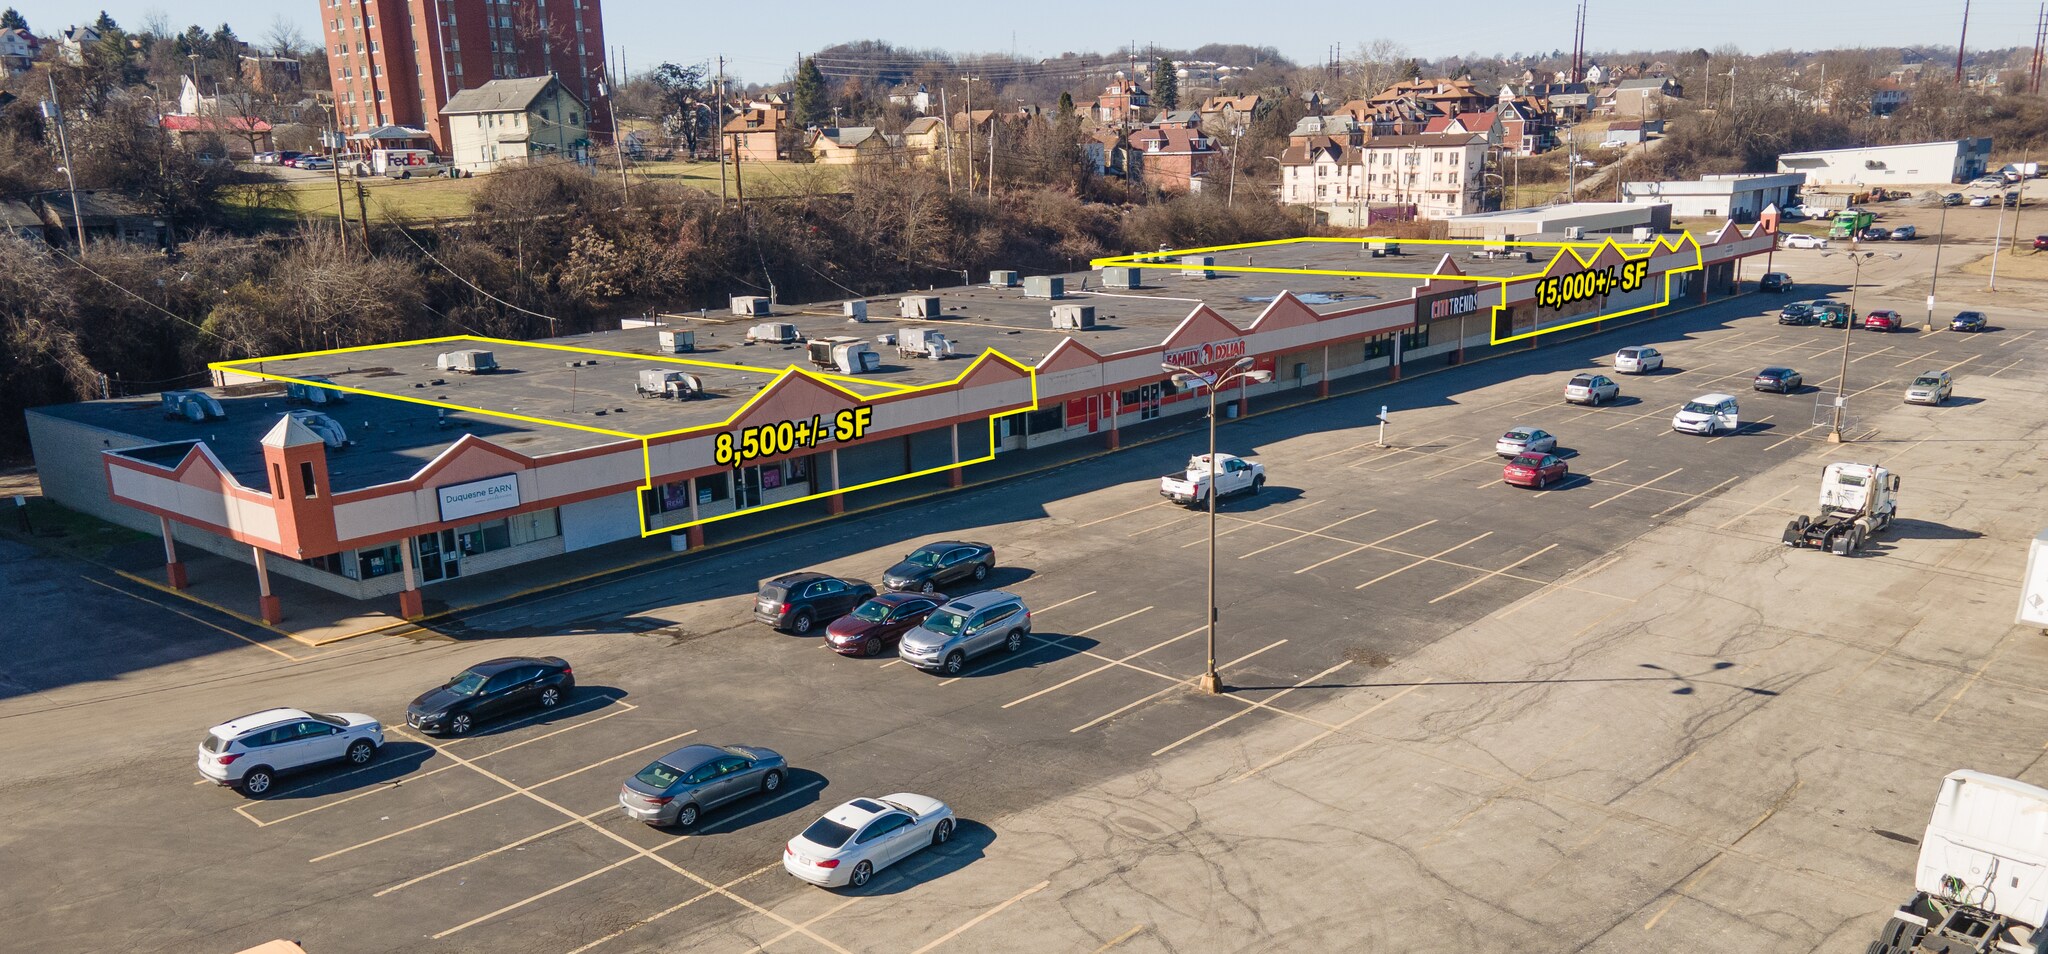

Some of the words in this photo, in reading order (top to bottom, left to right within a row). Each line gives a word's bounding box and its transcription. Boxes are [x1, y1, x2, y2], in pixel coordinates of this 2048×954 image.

[387, 152, 426, 167] FedEx
[1166, 349, 1200, 367] FAMILY
[1215, 340, 1246, 360] DOLLAR
[446, 490, 487, 503] Duquesne
[488, 484, 513, 495] EARN
